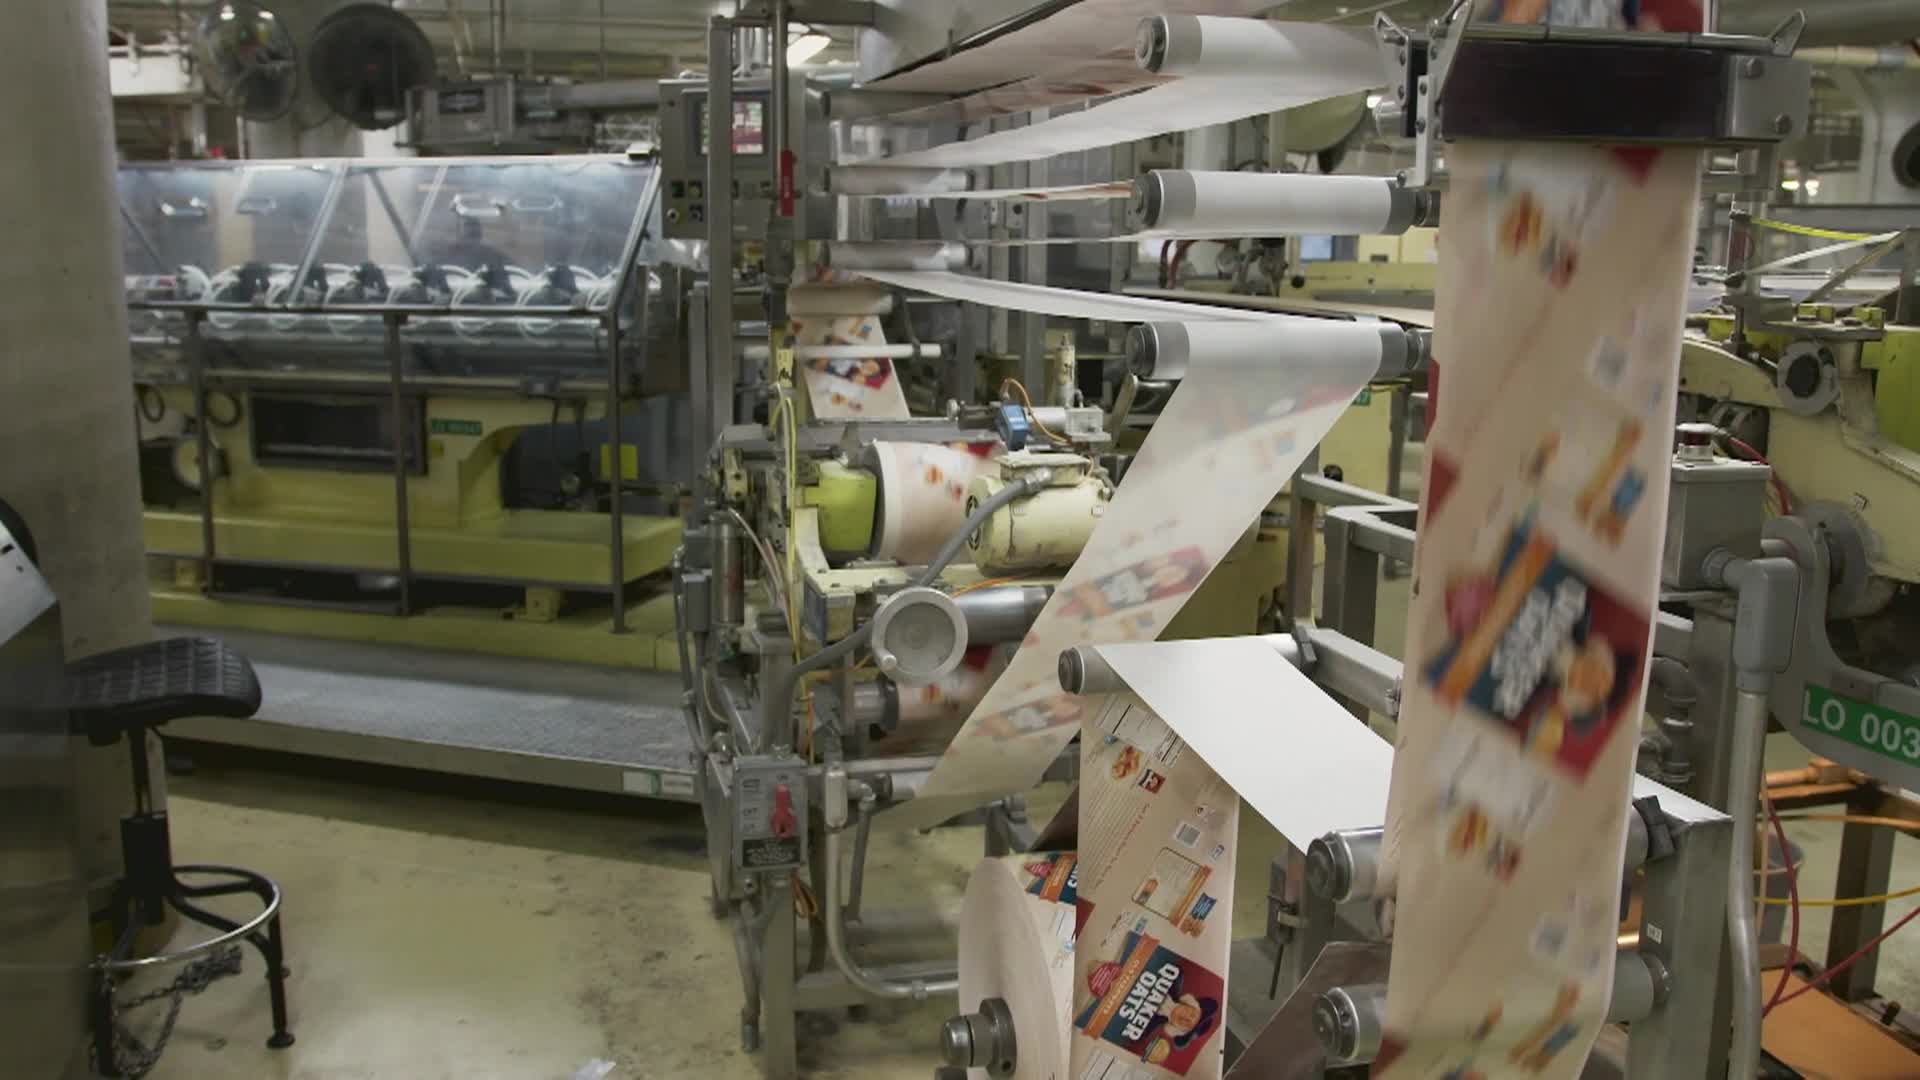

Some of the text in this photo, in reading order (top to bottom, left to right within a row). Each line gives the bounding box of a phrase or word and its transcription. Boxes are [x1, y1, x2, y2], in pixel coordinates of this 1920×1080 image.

[1802, 688, 1920, 759] LO 003
[1119, 971, 1158, 1021] OATS
[1121, 962, 1181, 1041] QUAKER
